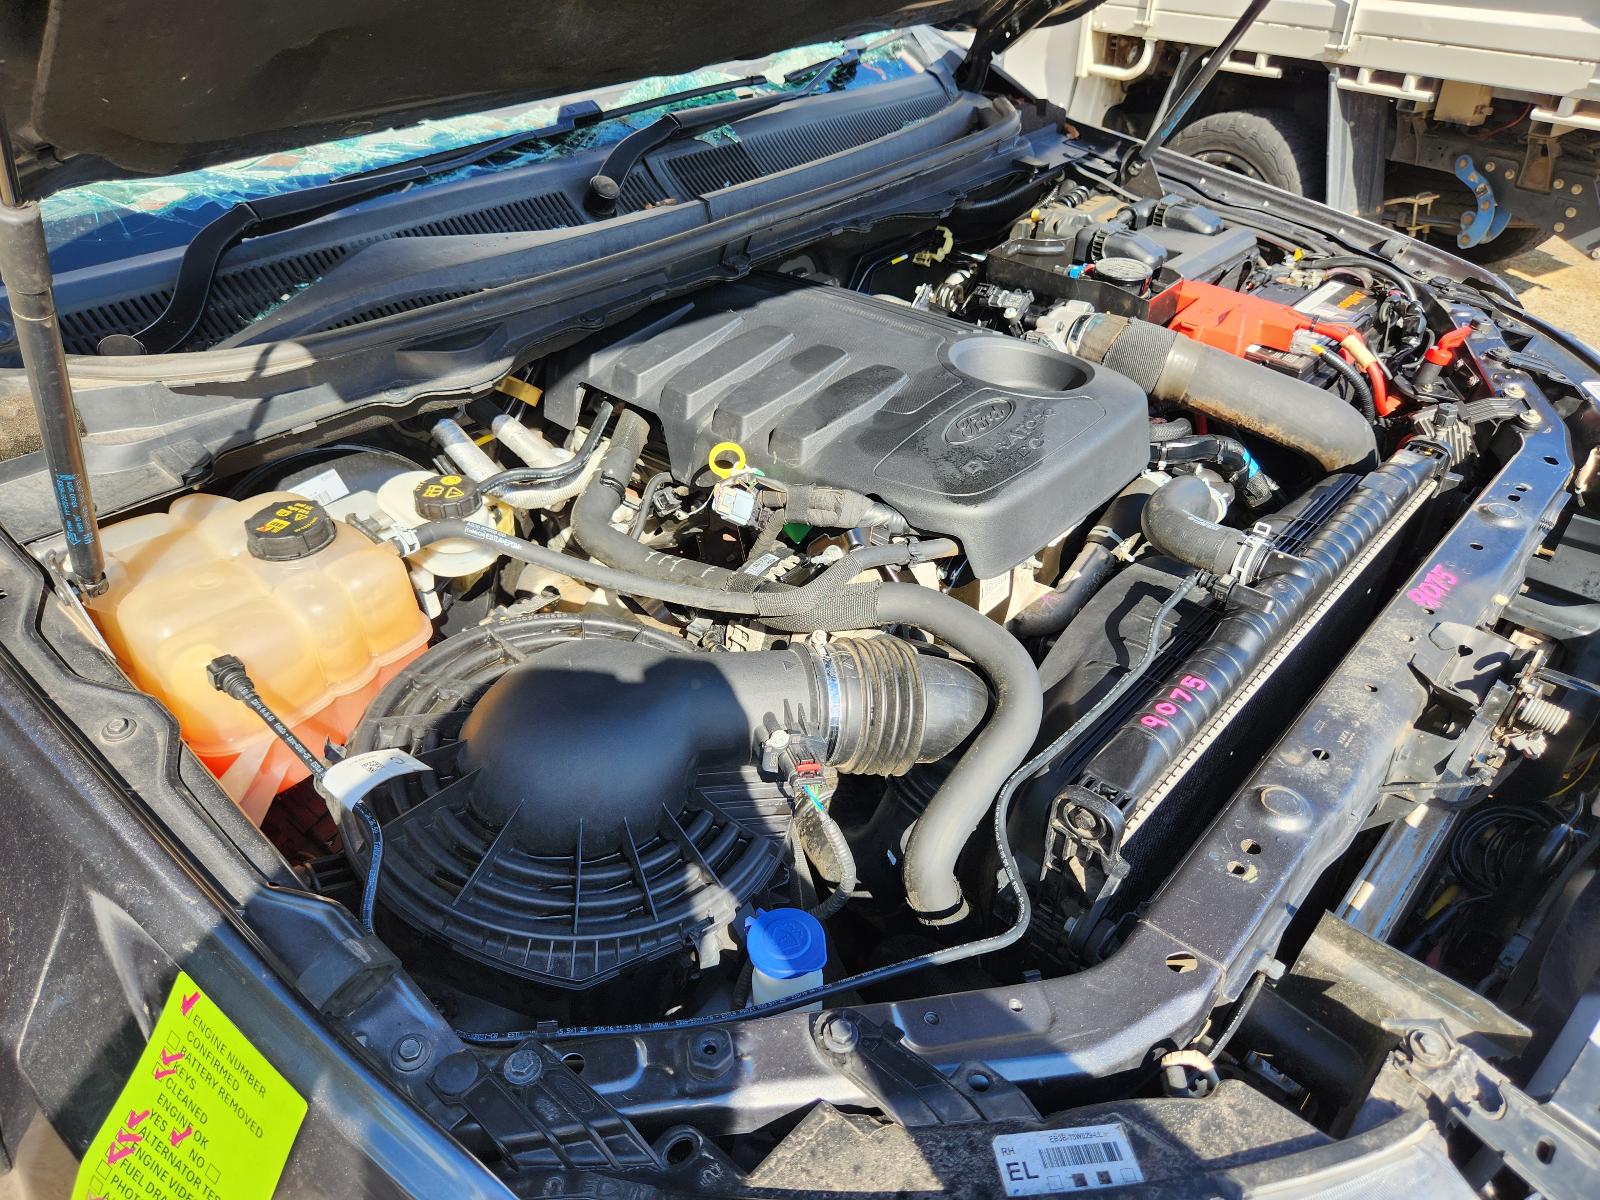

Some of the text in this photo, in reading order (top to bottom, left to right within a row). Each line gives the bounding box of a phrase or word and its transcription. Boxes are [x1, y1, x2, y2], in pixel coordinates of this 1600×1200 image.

[956, 404, 1005, 439] Ford
[1140, 673, 1208, 729] 9075
[173, 1061, 197, 1091] KEYS
[187, 1030, 240, 1092] CONFIRMED
[193, 1014, 266, 1099] ENGINE NUMBER
[165, 1077, 208, 1125] CLEANED
[180, 1045, 263, 1138] BATTERY REMOVED
[149, 1108, 205, 1169] YES NO
[157, 1092, 209, 1150] ENGINE OK
[120, 1157, 144, 1188] FUEL
[132, 1142, 170, 1183] ENGINE
[138, 1126, 202, 1190] ALTERNATOR
[1001, 1146, 1015, 1156] RH
[1006, 1161, 1039, 1181] EL
